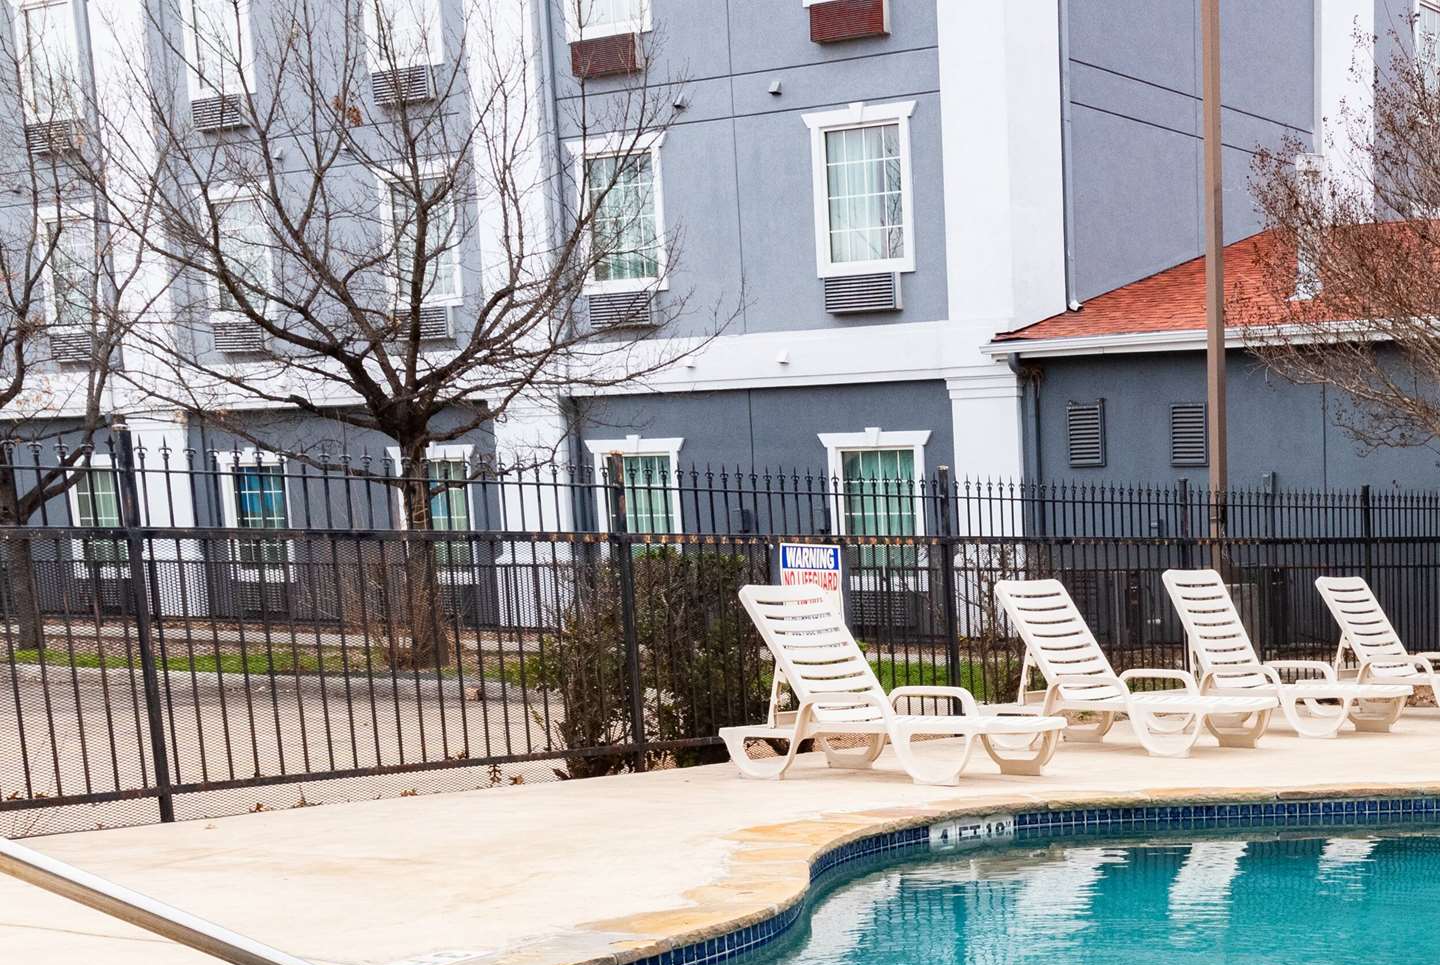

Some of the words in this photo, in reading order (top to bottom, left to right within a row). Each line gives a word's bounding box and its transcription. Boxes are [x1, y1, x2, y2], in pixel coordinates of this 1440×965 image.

[786, 547, 835, 569] WARNING
[784, 571, 795, 586] NO
[797, 571, 838, 591] LIFEGUARD
